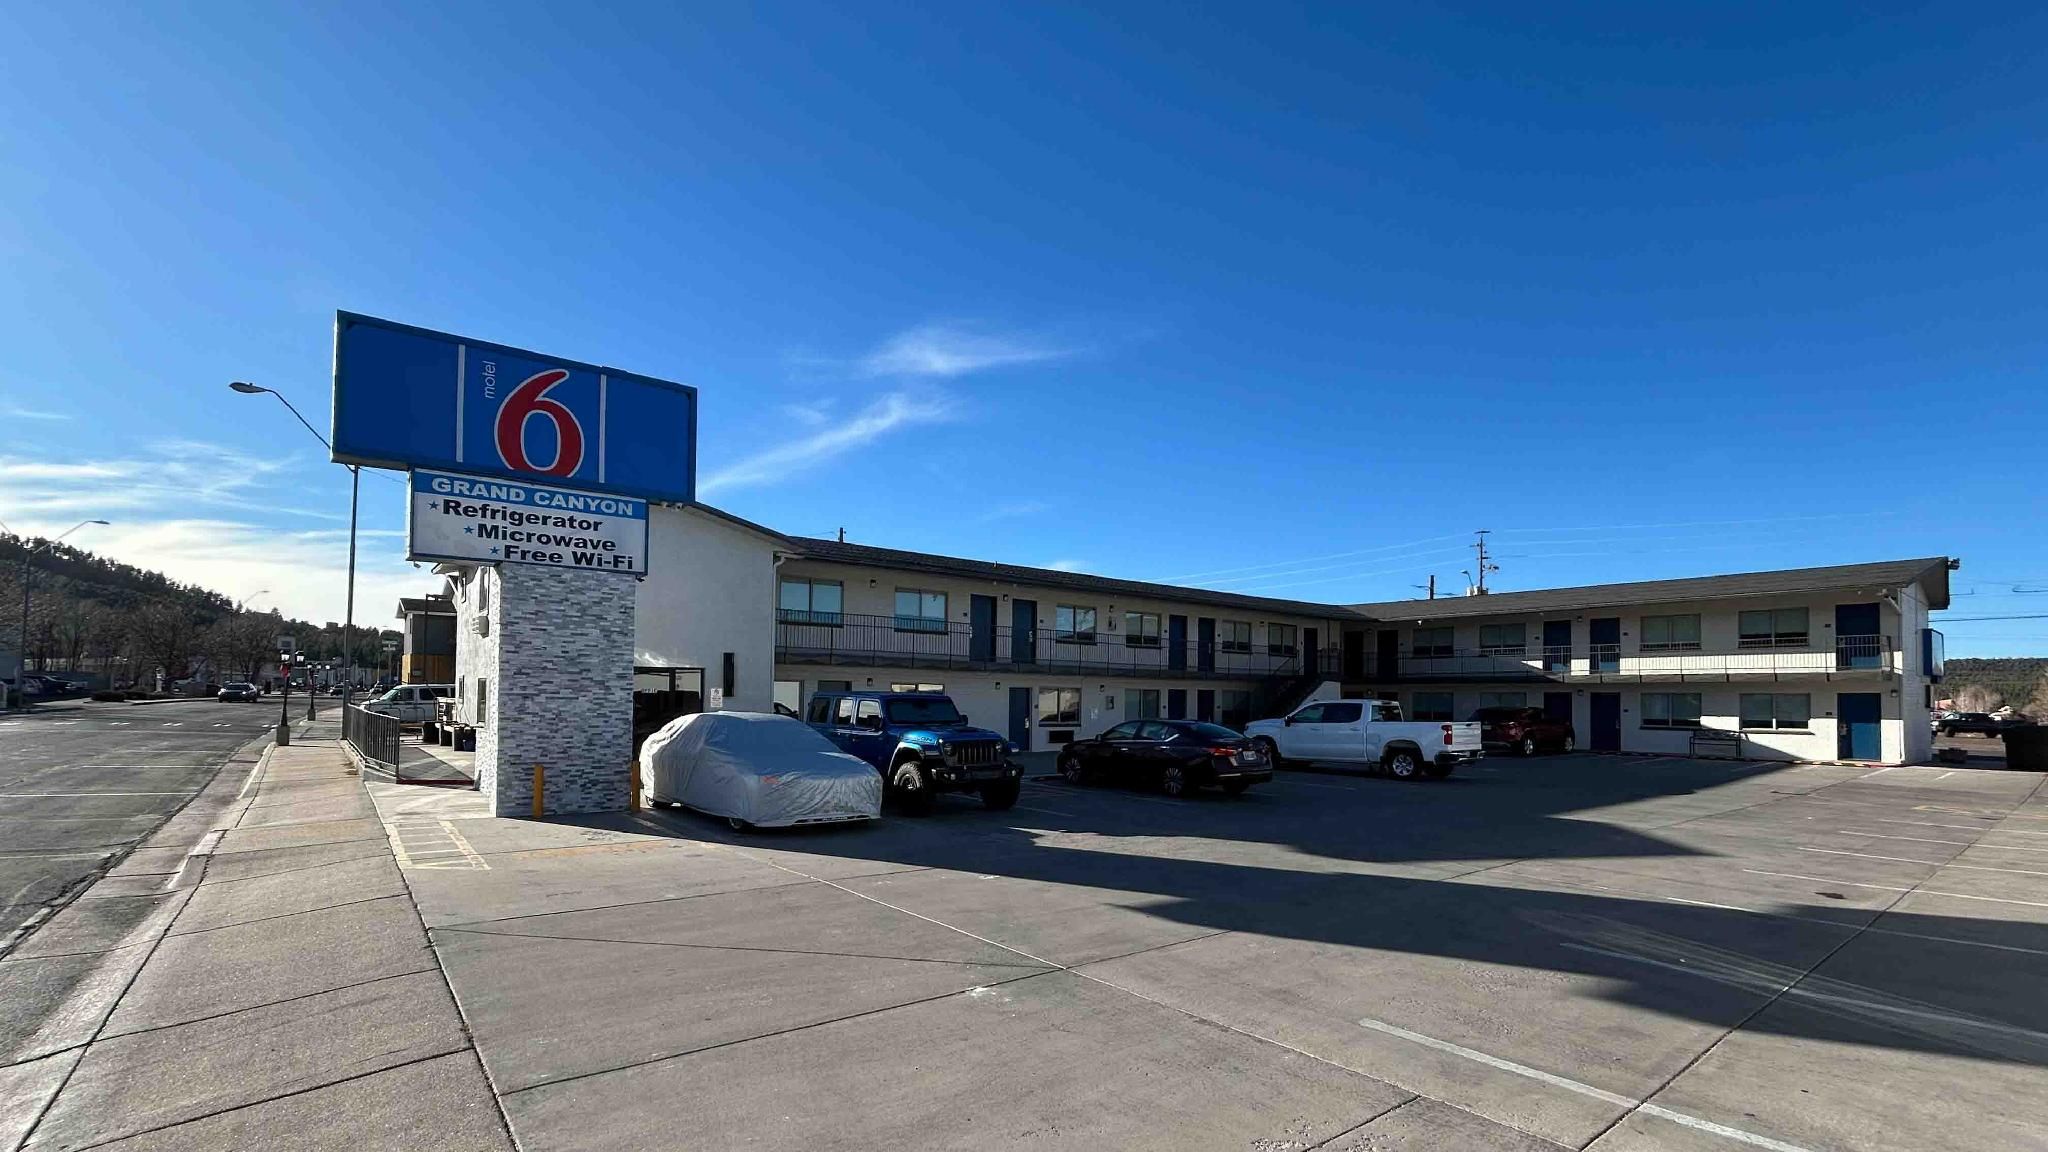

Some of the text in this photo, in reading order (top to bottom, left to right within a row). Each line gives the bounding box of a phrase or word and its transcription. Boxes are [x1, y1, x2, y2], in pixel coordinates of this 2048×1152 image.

[482, 361, 496, 399] motel
[494, 369, 585, 477] 6
[432, 478, 633, 516] GRAND CANYON
[443, 499, 603, 531] Refrigerator
[477, 523, 616, 552] Microwave
[504, 545, 633, 570] Free Wi-Fi
